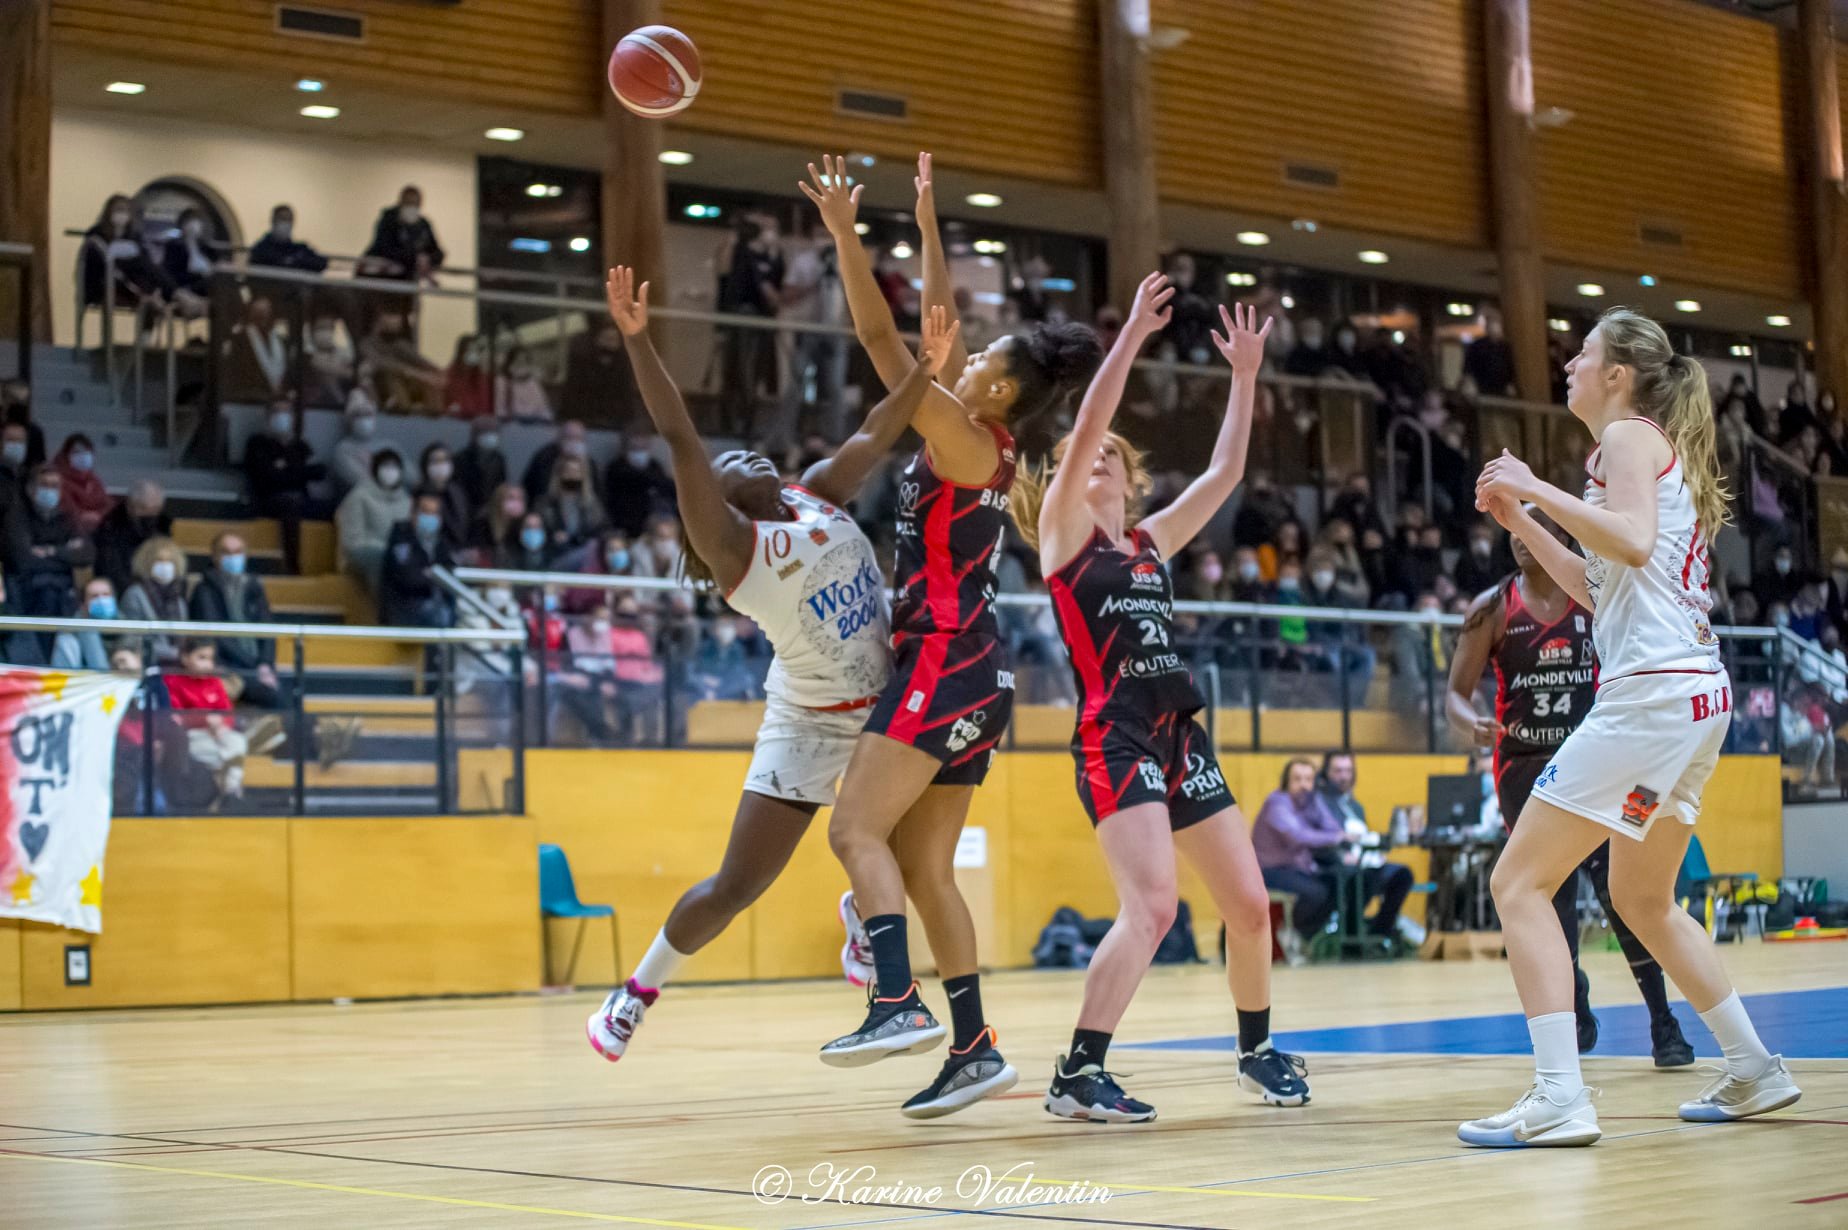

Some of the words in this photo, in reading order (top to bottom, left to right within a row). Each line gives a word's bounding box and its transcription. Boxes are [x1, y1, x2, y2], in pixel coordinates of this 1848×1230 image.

[765, 529, 791, 568] 10
[806, 558, 877, 621] Work
[838, 595, 877, 640] 2000
[1510, 668, 1593, 691] MONDEVILLE
[1533, 693, 1571, 717] 34
[1181, 766, 1224, 798] PRN
